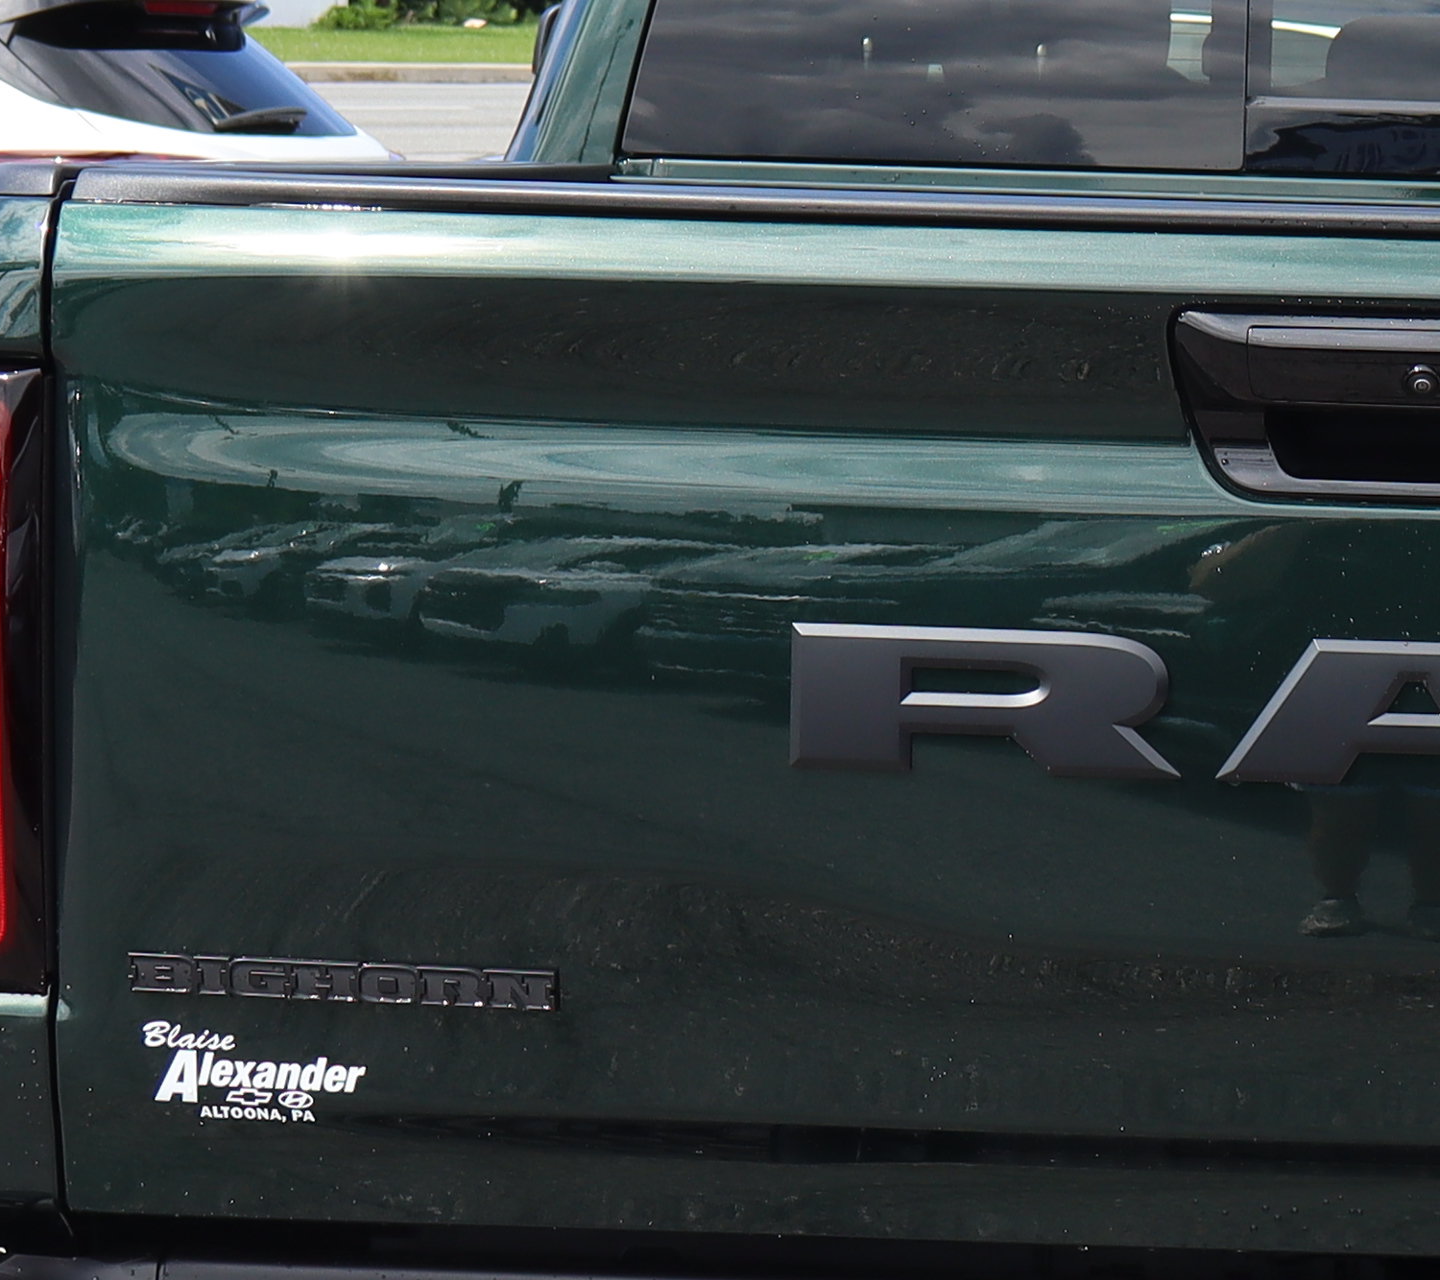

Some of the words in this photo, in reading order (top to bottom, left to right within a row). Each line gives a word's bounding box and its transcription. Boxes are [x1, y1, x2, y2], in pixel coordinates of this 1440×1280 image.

[127, 951, 559, 1012] BIGHORN
[142, 1020, 236, 1051] Blaise
[154, 1049, 367, 1104] Alexander
[200, 1105, 287, 1123] ALTOONA,
[291, 1108, 316, 1122] PA
